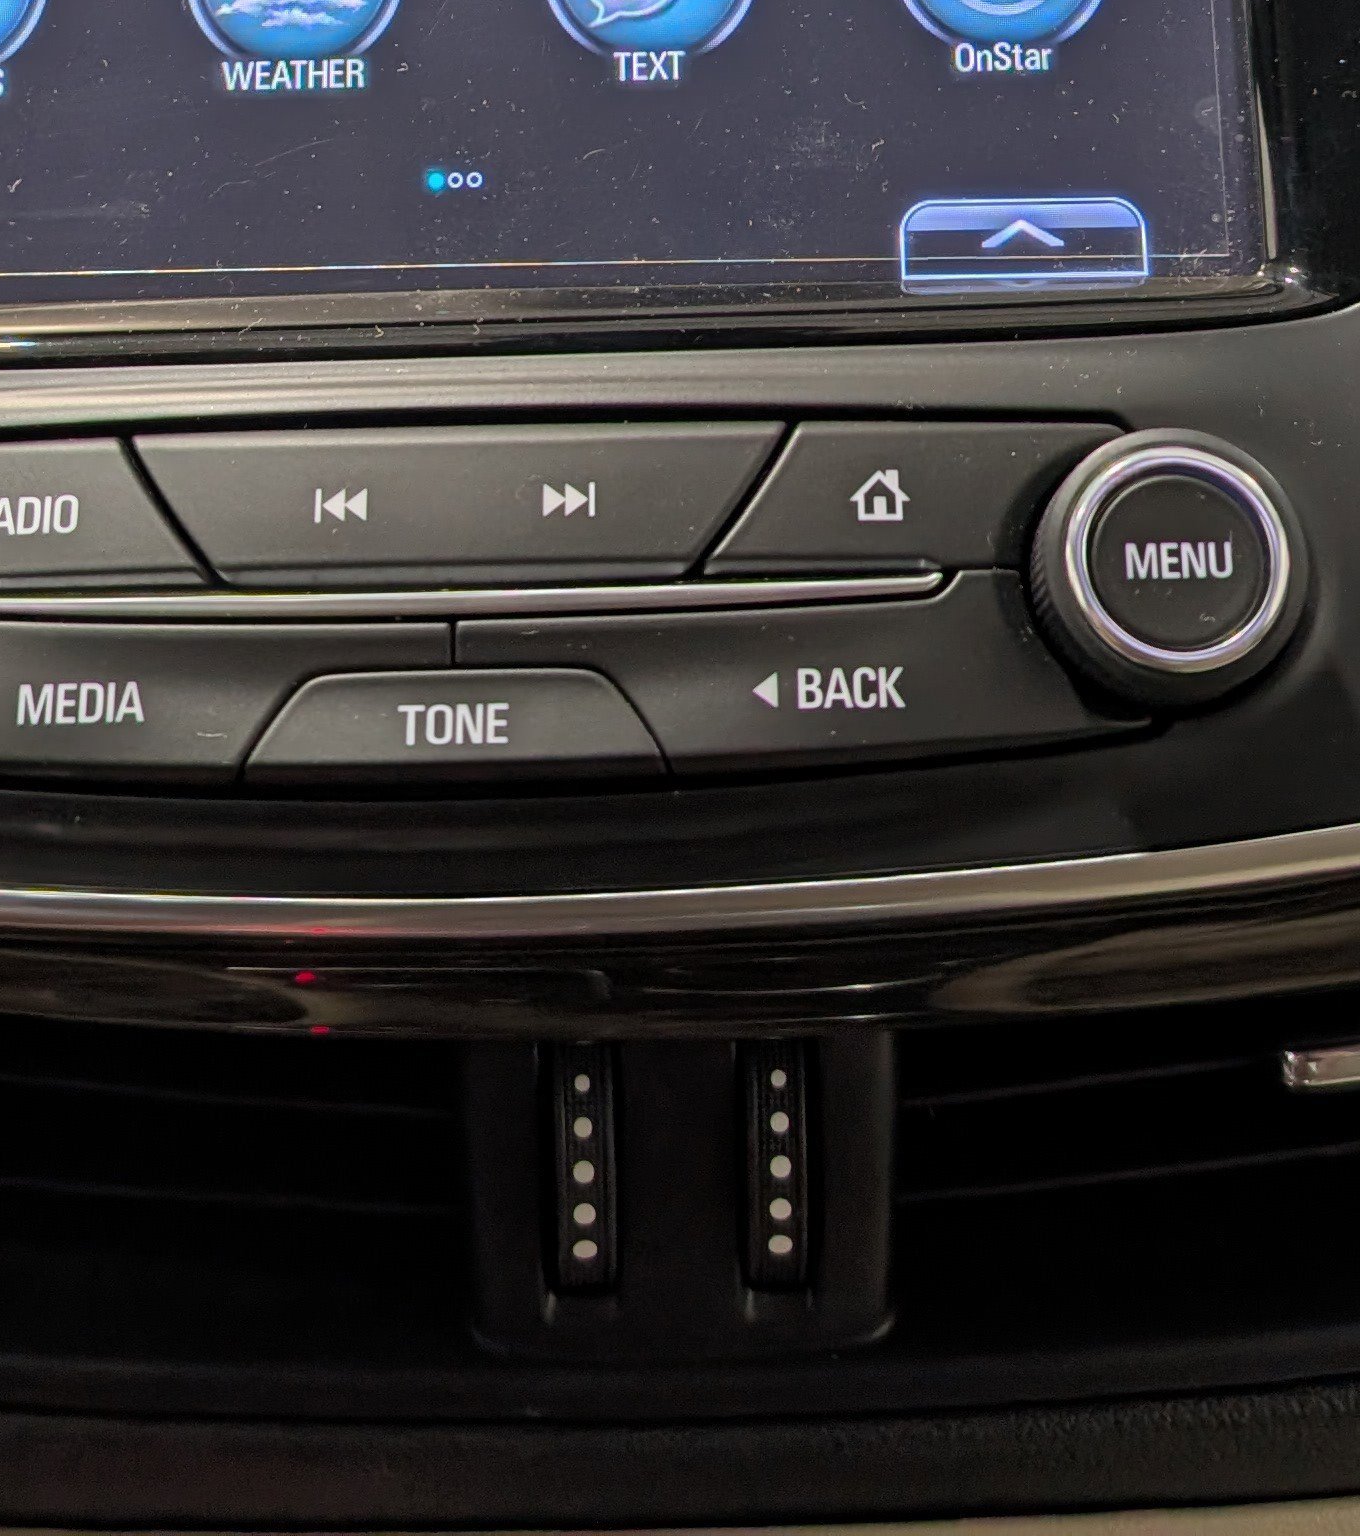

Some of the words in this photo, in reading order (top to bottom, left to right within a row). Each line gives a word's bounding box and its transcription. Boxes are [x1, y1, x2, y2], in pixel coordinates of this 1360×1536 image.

[221, 58, 366, 91] WEATHER
[613, 50, 686, 82] TEXT
[953, 41, 1053, 73] OnStar
[1124, 541, 1234, 580] MENU
[16, 681, 145, 726] MEDIA
[797, 666, 906, 710] BACK
[397, 702, 510, 746] TONE
